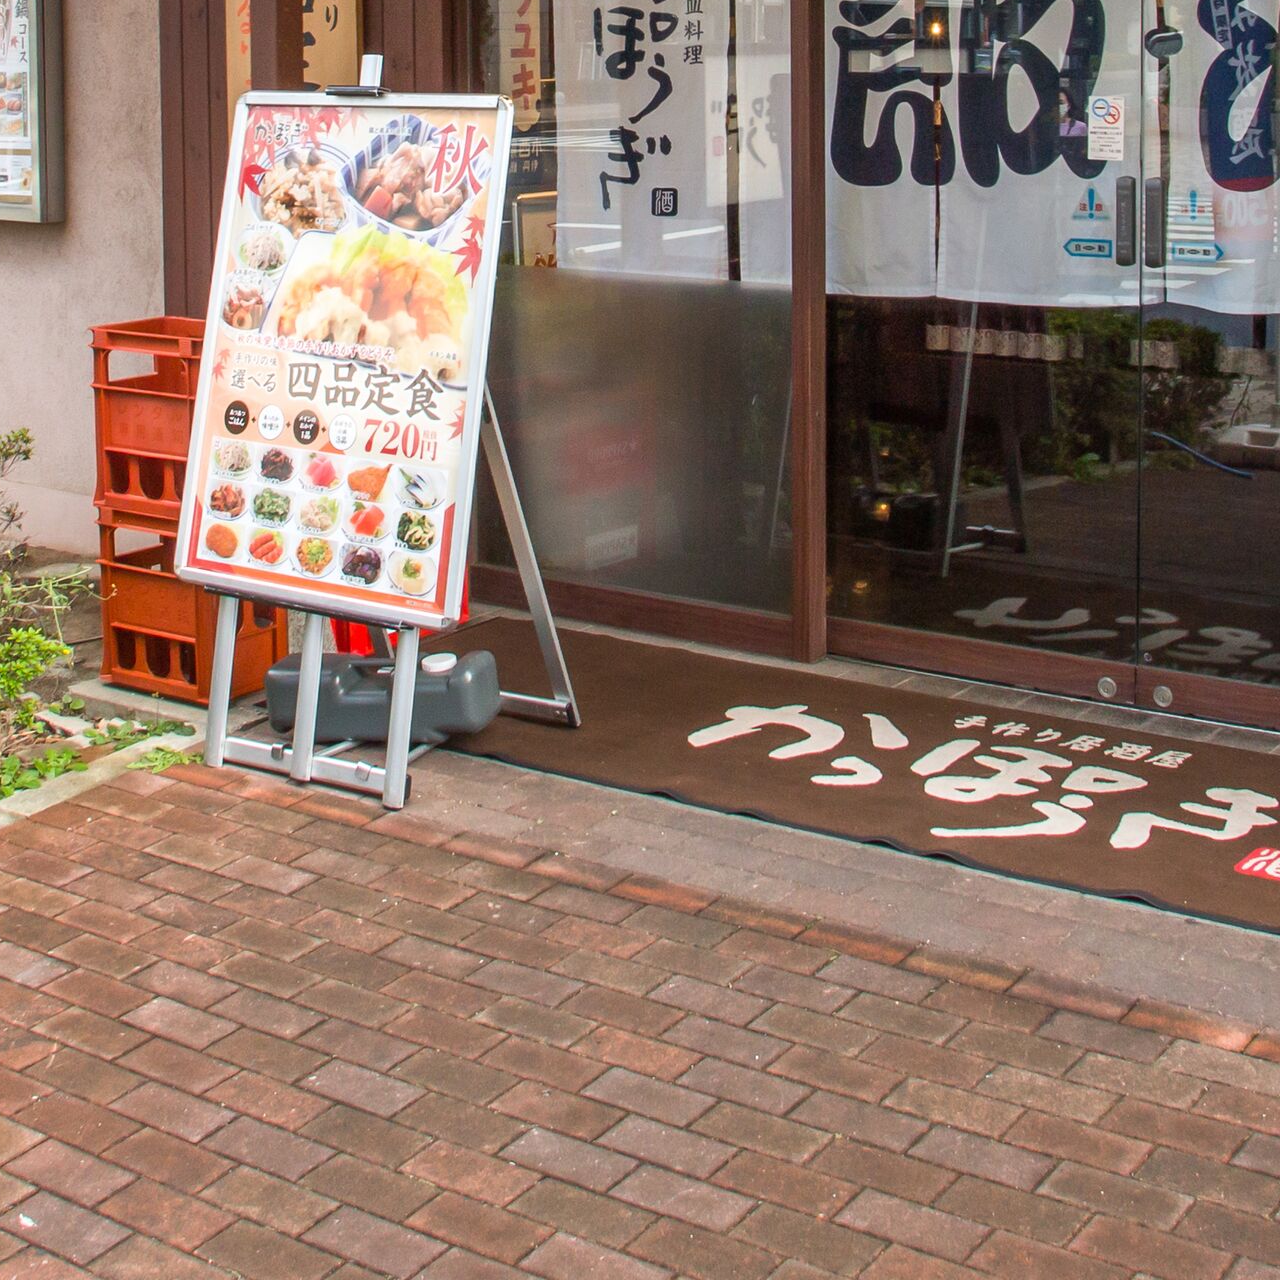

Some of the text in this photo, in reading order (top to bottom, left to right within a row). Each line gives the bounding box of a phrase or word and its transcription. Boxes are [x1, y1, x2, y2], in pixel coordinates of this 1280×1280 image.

[254, 120, 309, 148] かっぽうぎ
[427, 123, 490, 196] 秋
[230, 368, 278, 394] 選べる
[287, 361, 445, 422] 四品定食
[363, 417, 439, 462] 720円
[953, 714, 1192, 771] 手作り居酒屋
